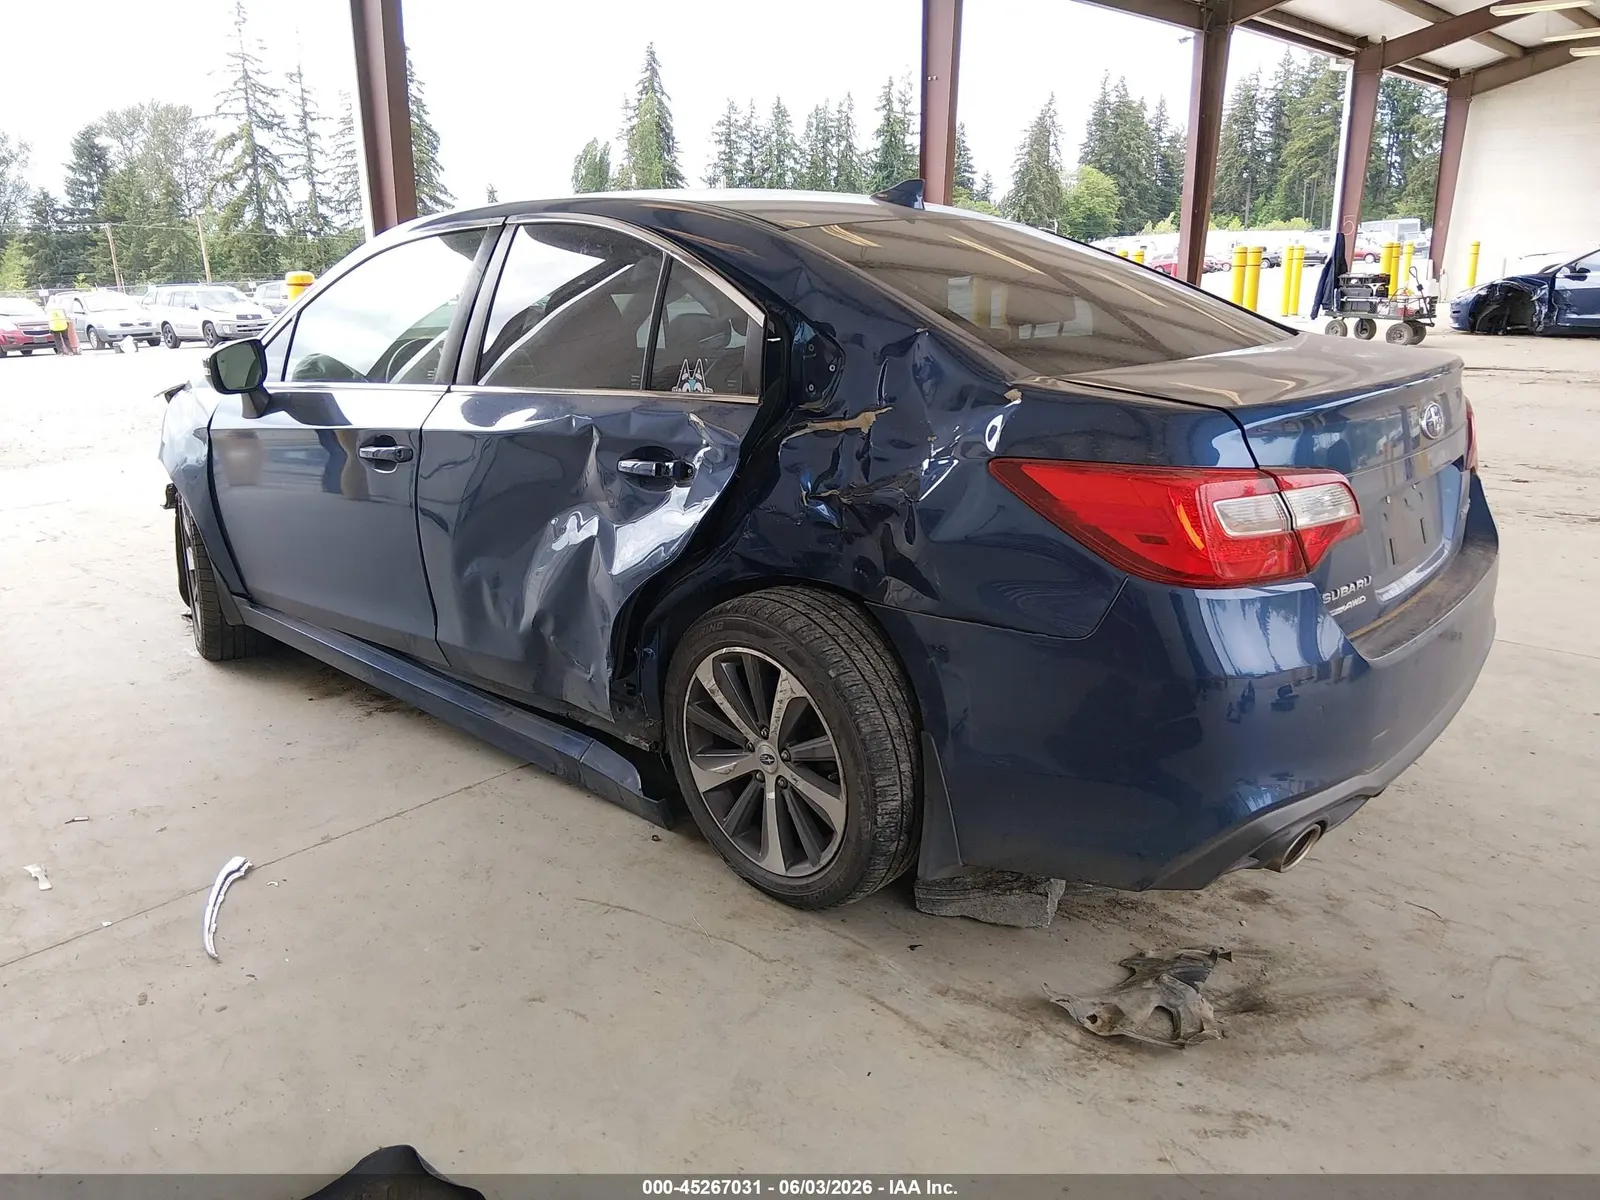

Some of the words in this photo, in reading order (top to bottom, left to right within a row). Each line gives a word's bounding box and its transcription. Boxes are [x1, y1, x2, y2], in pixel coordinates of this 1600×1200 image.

[1342, 214, 1355, 236] 5
[1322, 575, 1372, 604] SUBARU
[1343, 595, 1367, 611] AWD
